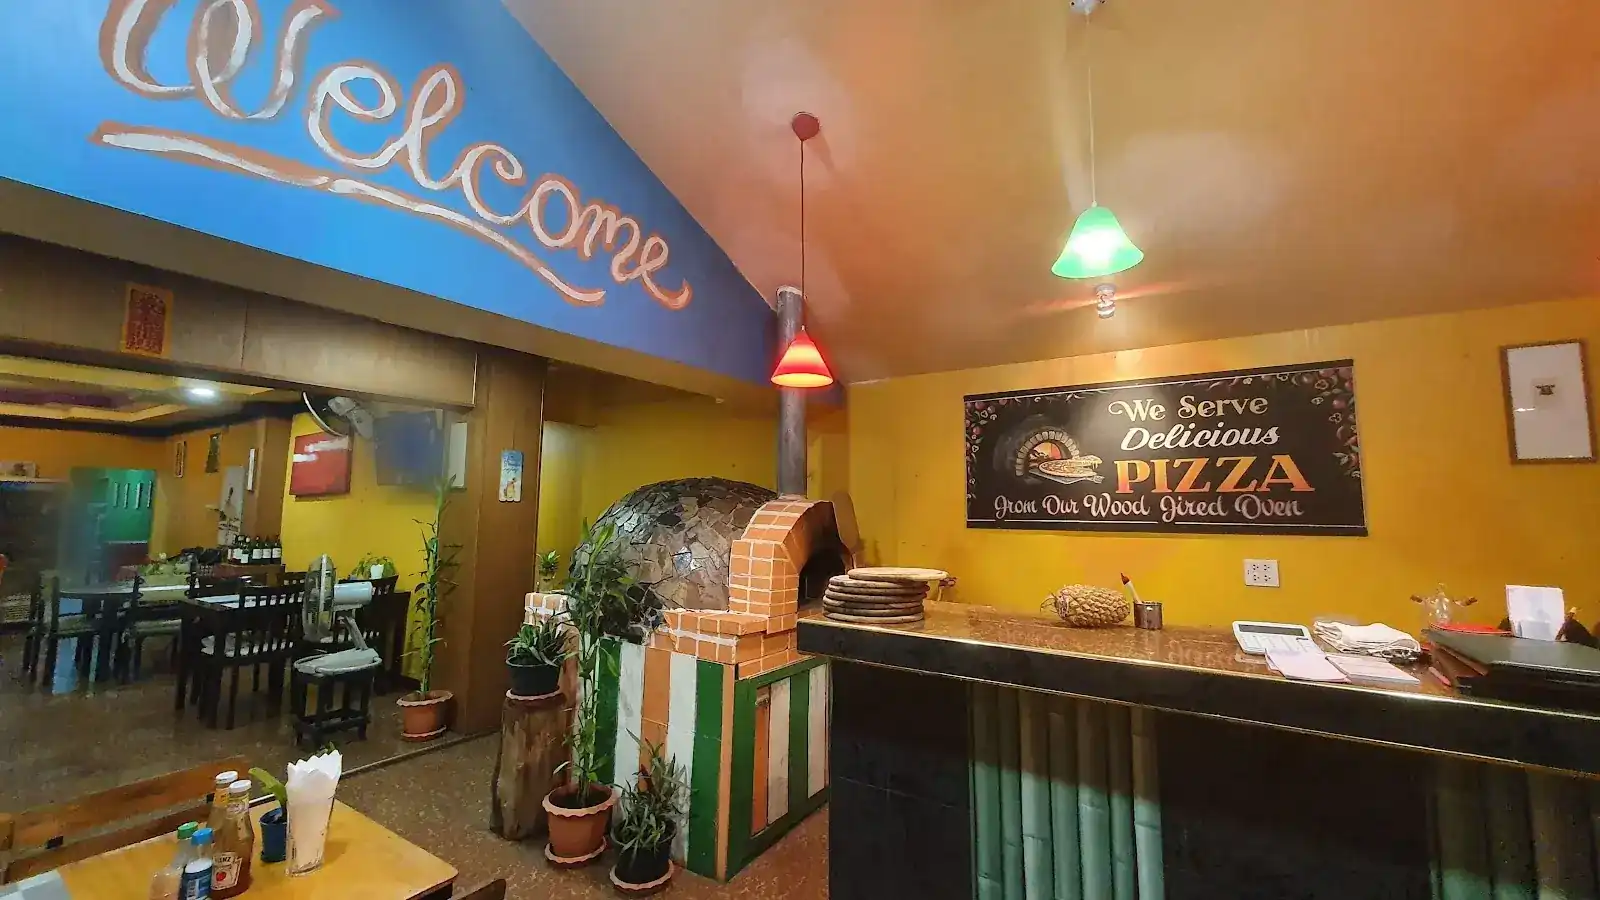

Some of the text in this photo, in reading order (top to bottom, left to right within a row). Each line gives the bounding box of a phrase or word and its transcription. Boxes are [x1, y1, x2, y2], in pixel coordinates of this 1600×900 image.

[100, 0, 691, 309] Welcome
[1108, 395, 1268, 421] We Serve
[1120, 421, 1280, 451] Delicious
[1114, 454, 1315, 494] PIZZA
[994, 492, 1304, 523] From Our Wood Fired Oven
